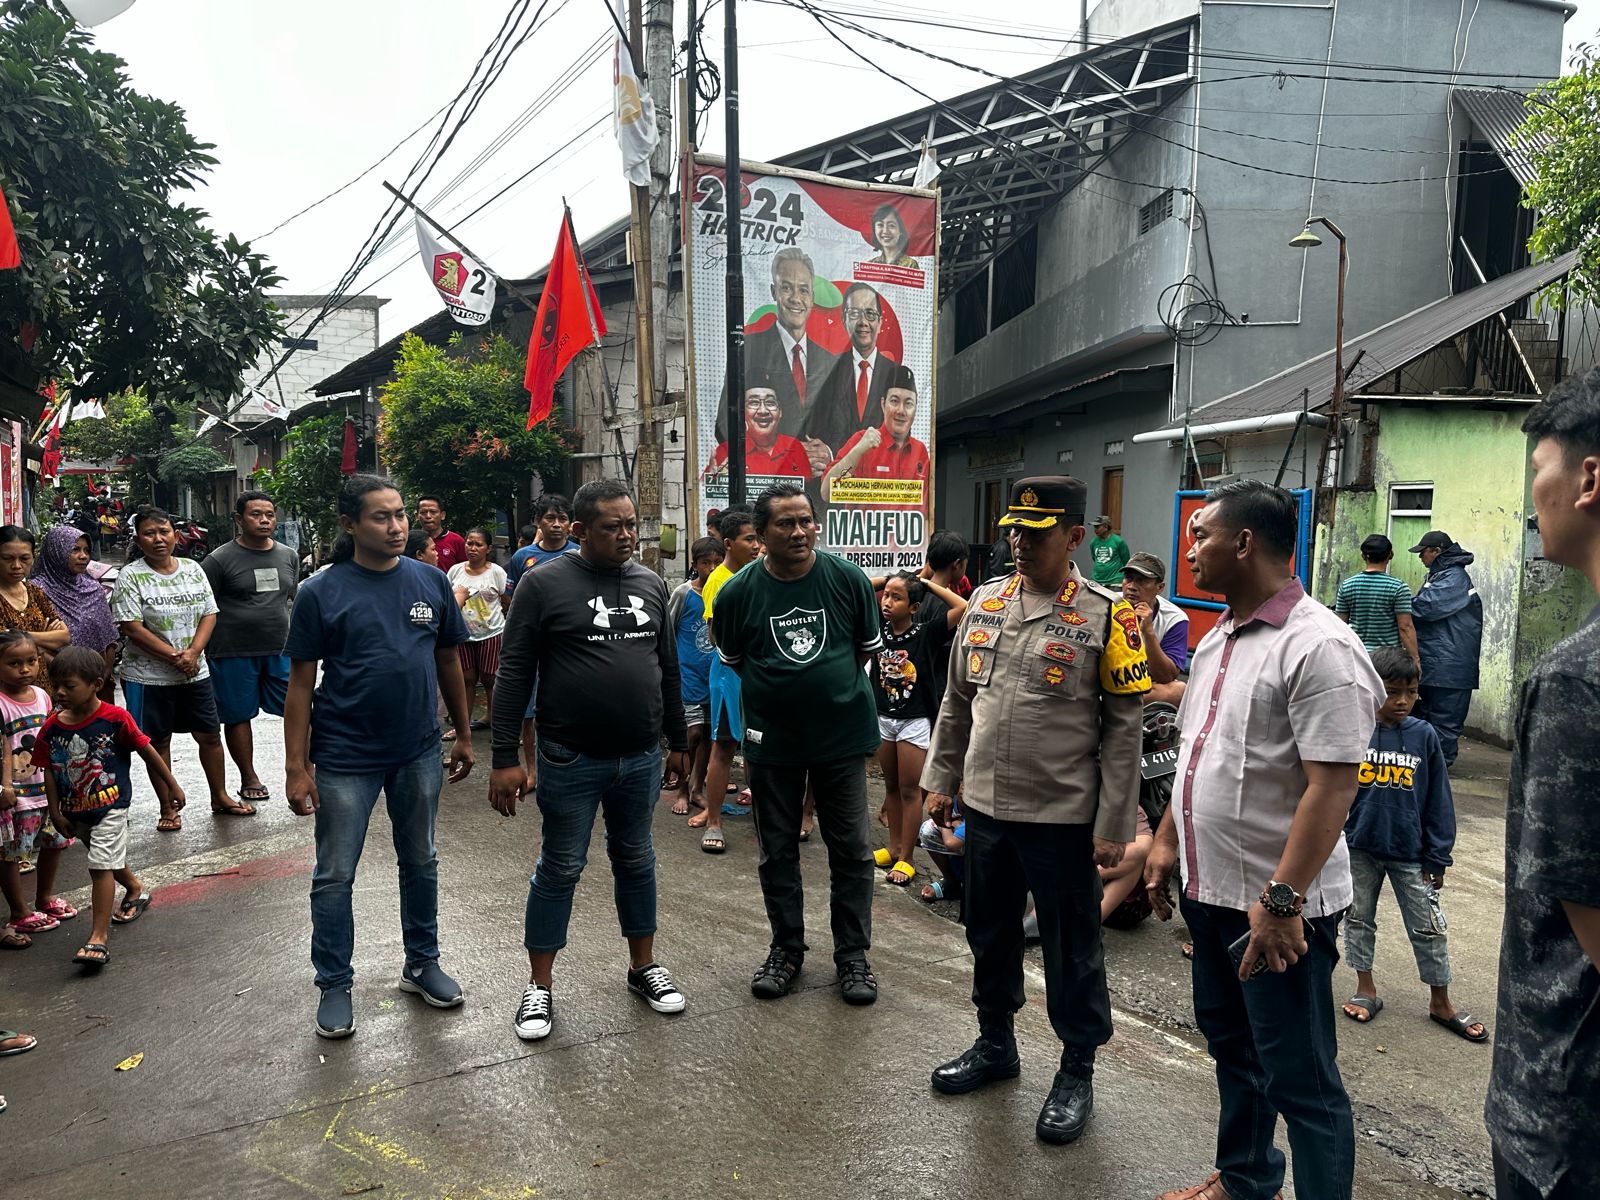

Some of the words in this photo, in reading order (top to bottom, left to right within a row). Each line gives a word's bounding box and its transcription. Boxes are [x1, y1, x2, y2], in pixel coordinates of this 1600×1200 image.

[699, 213, 801, 246] HATRICK
[470, 269, 486, 296] 2
[828, 511, 923, 546] MAHFUD
[897, 552, 923, 567] 2024
[145, 592, 206, 606] QUIKSILVER
[778, 615, 818, 628] MOUTLEY
[972, 614, 1005, 626] IRWAN
[1044, 623, 1092, 644] POLRI
[1152, 749, 1177, 764] 4716
[1358, 762, 1413, 787] GUYS
